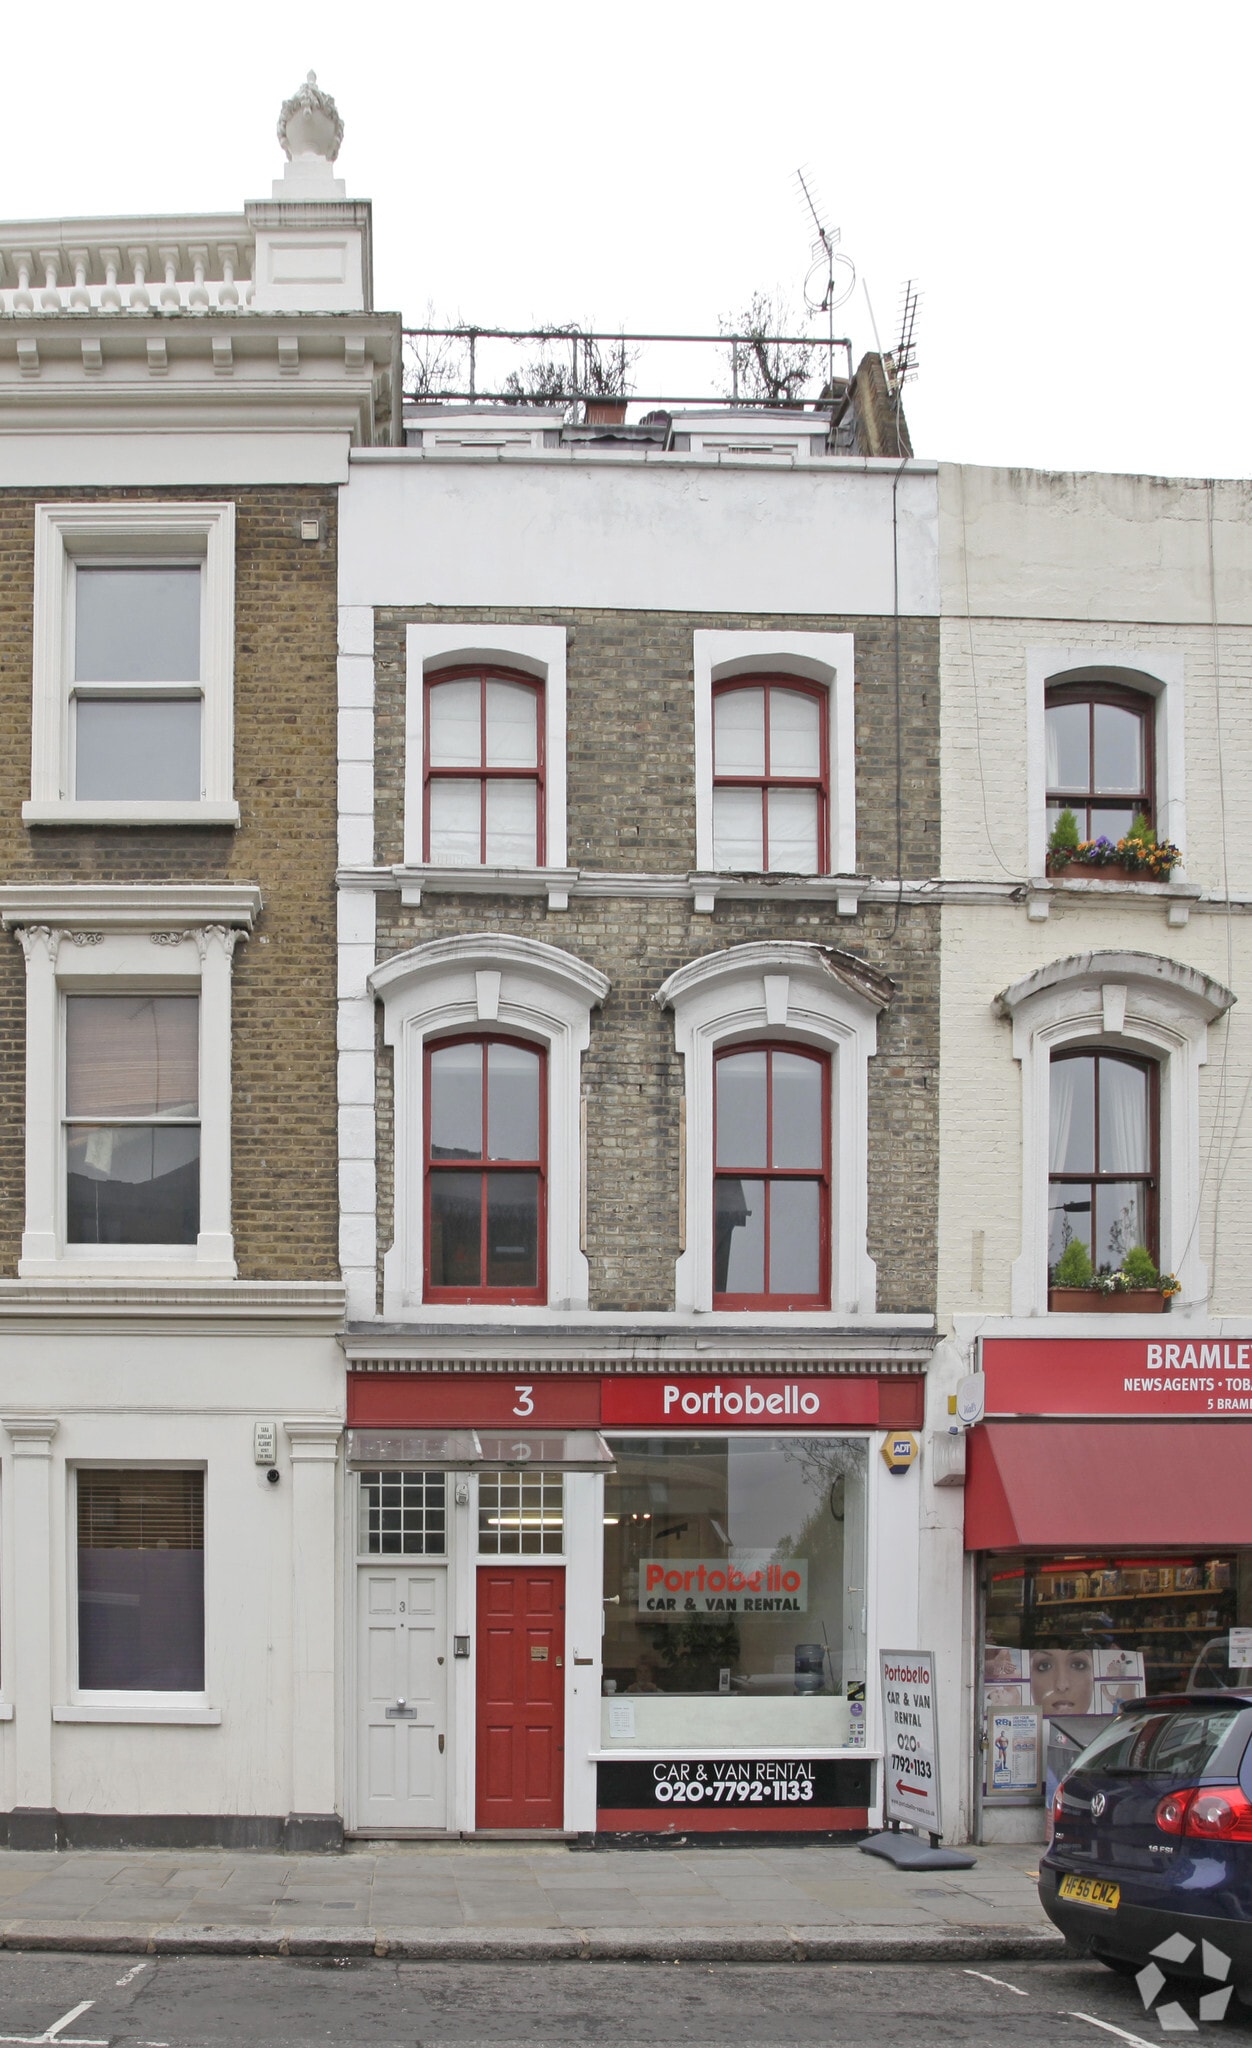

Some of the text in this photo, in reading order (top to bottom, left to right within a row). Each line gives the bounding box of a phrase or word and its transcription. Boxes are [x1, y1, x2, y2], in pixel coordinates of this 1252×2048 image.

[1147, 1344, 1252, 1369] BRAMLE
[1124, 1378, 1252, 1392] NEWSAGENTS TOB
[512, 1385, 534, 1416] 3
[663, 1385, 820, 1415] Portobello
[1207, 1398, 1214, 1410] 5
[894, 1443, 911, 1454] ADT
[646, 1564, 801, 1592] Portobello
[399, 1600, 406, 1613] 3
[647, 1597, 801, 1611] CAR & VAN RENTAL
[884, 1663, 930, 1685] Portobello
[887, 1691, 930, 1709] CAR & VAN
[894, 1710, 922, 1728] RENTAL
[653, 1762, 816, 1781] CAR & VAN RENTAL
[1063, 1876, 1092, 1897] HF56
